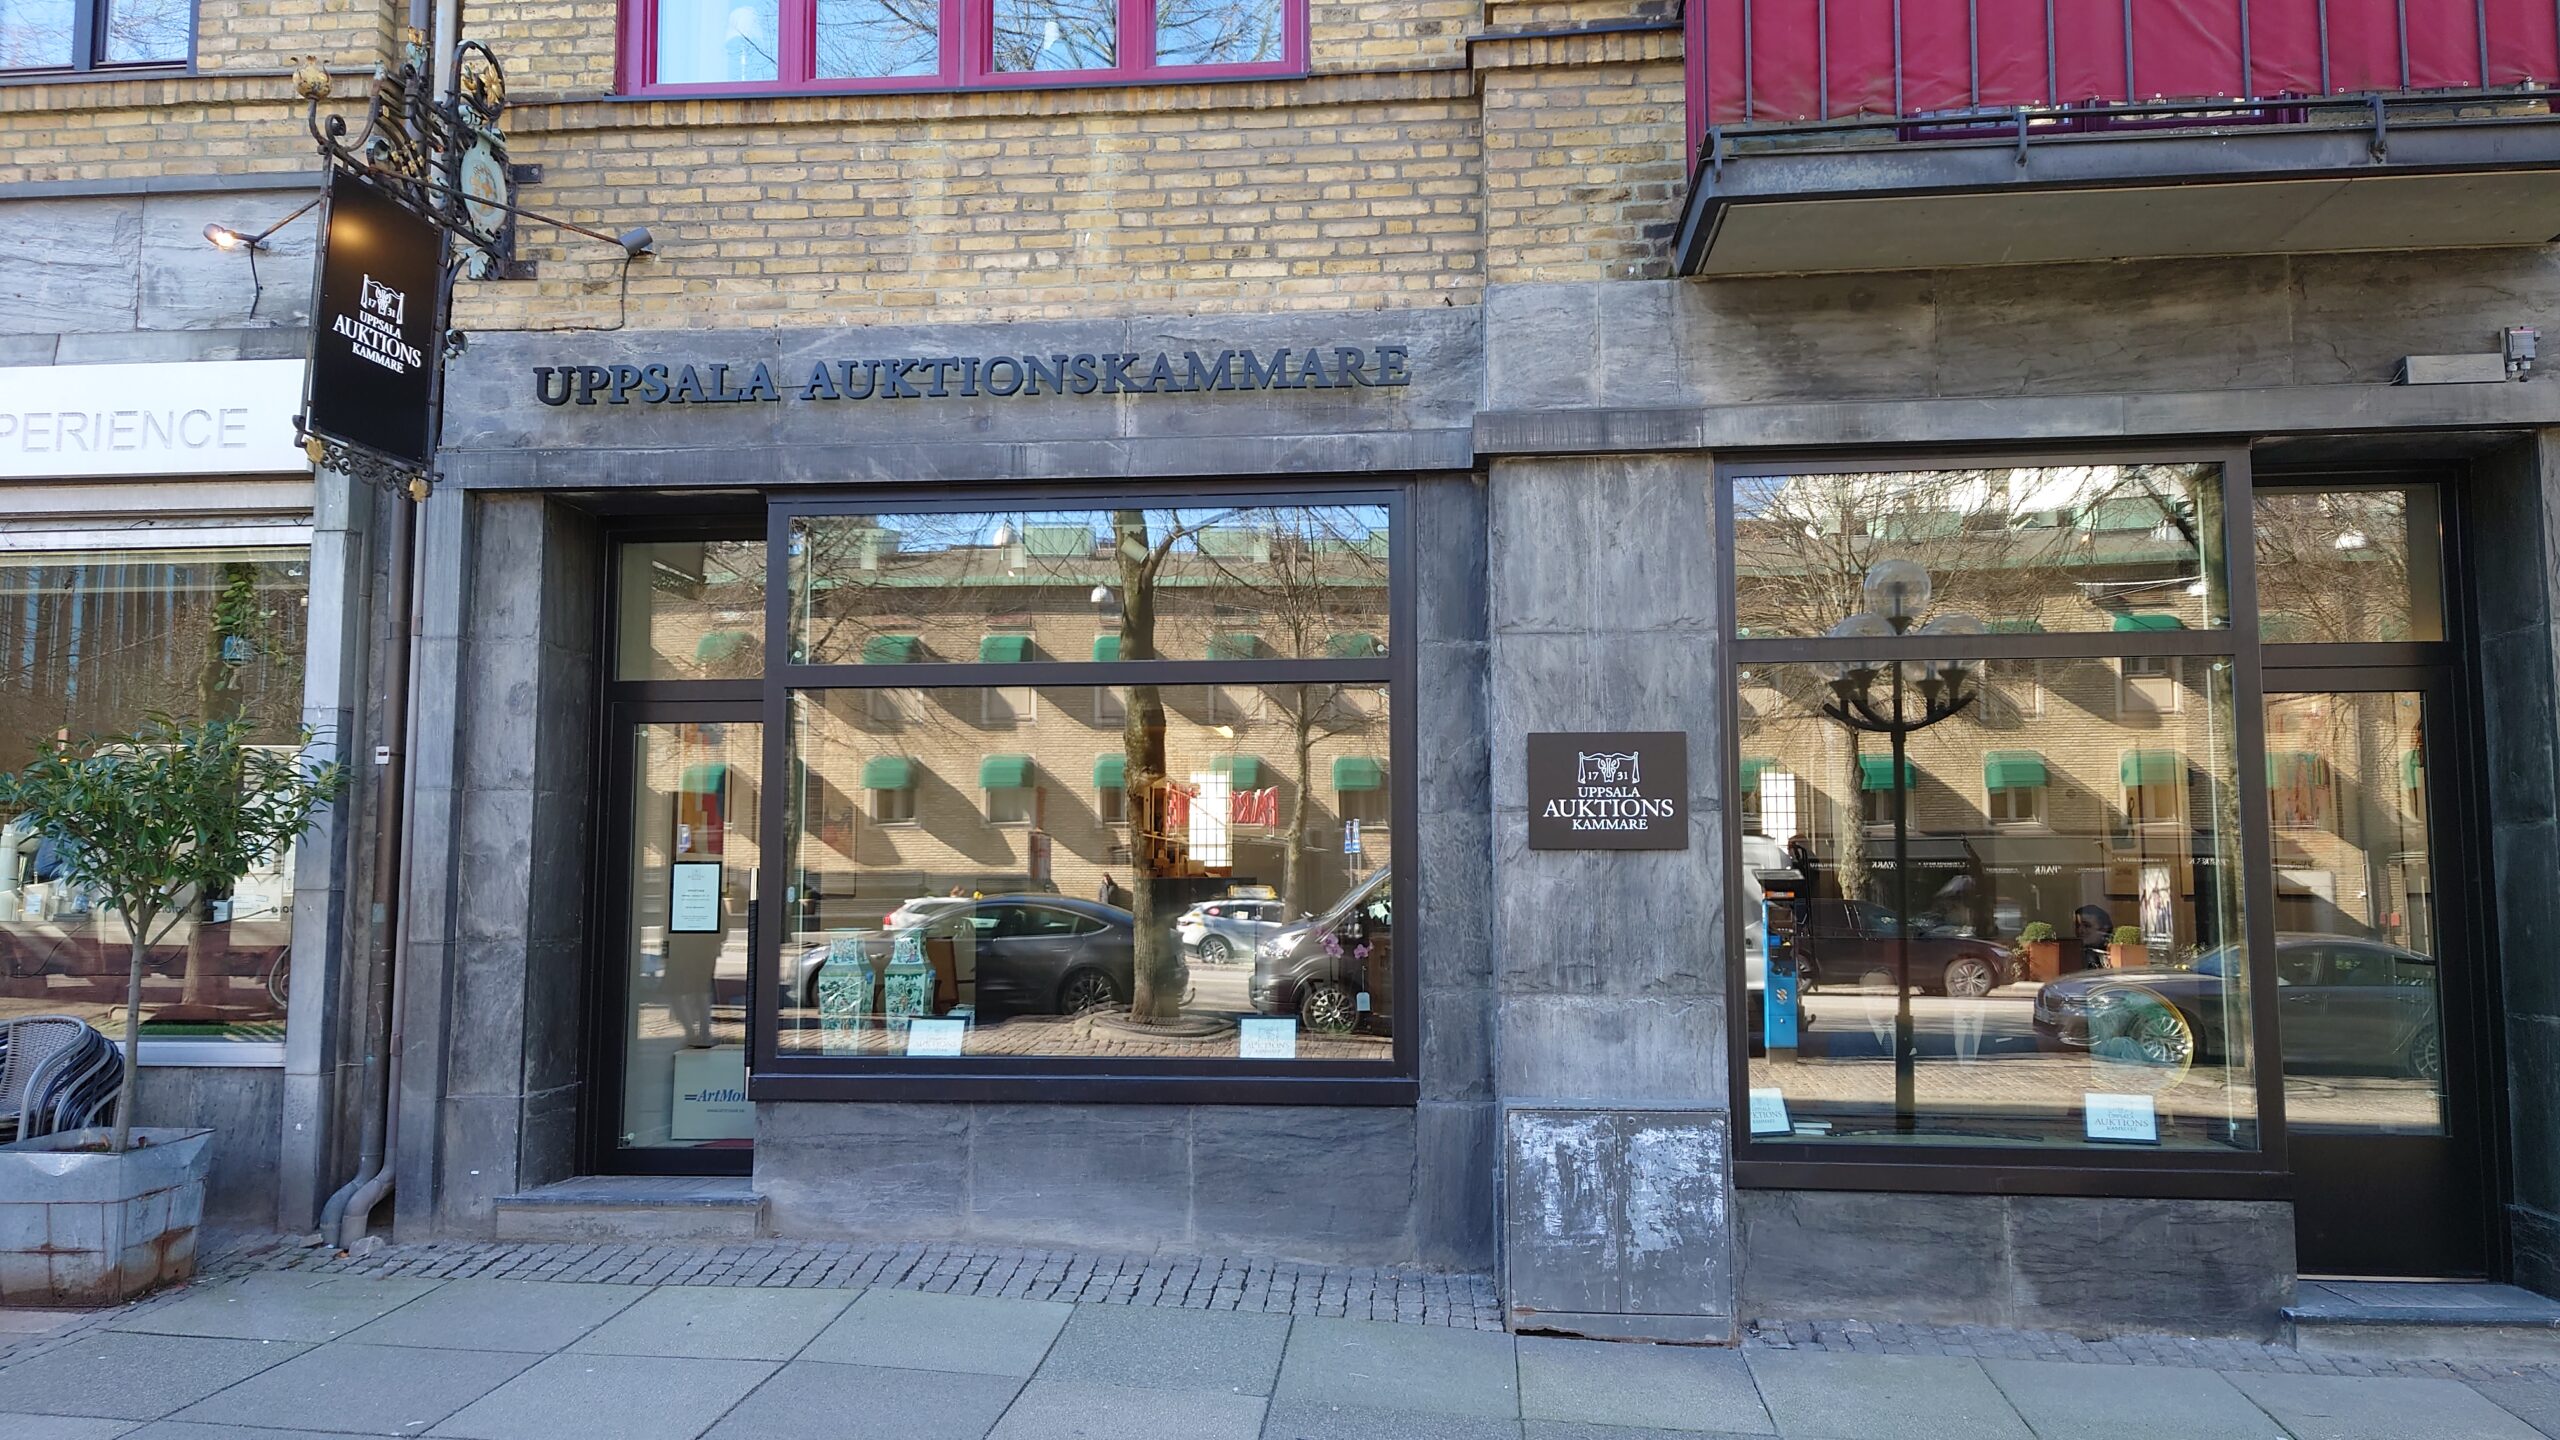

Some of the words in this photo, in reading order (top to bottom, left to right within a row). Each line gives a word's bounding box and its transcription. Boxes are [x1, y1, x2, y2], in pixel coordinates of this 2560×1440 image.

[360, 309, 402, 340] UPPSALA
[332, 313, 422, 368] AUKTIONS
[352, 341, 405, 374] KAMMARE
[532, 361, 780, 406] UPPSALA
[800, 345, 1412, 400] AUKTIONSKAMMARE
[1587, 771, 1599, 781] 17
[1616, 771, 1628, 781] 31
[1577, 786, 1641, 798] UPPSALA
[1542, 798, 1675, 818] AUKTIONS
[1572, 818, 1649, 830] KAMMARE
